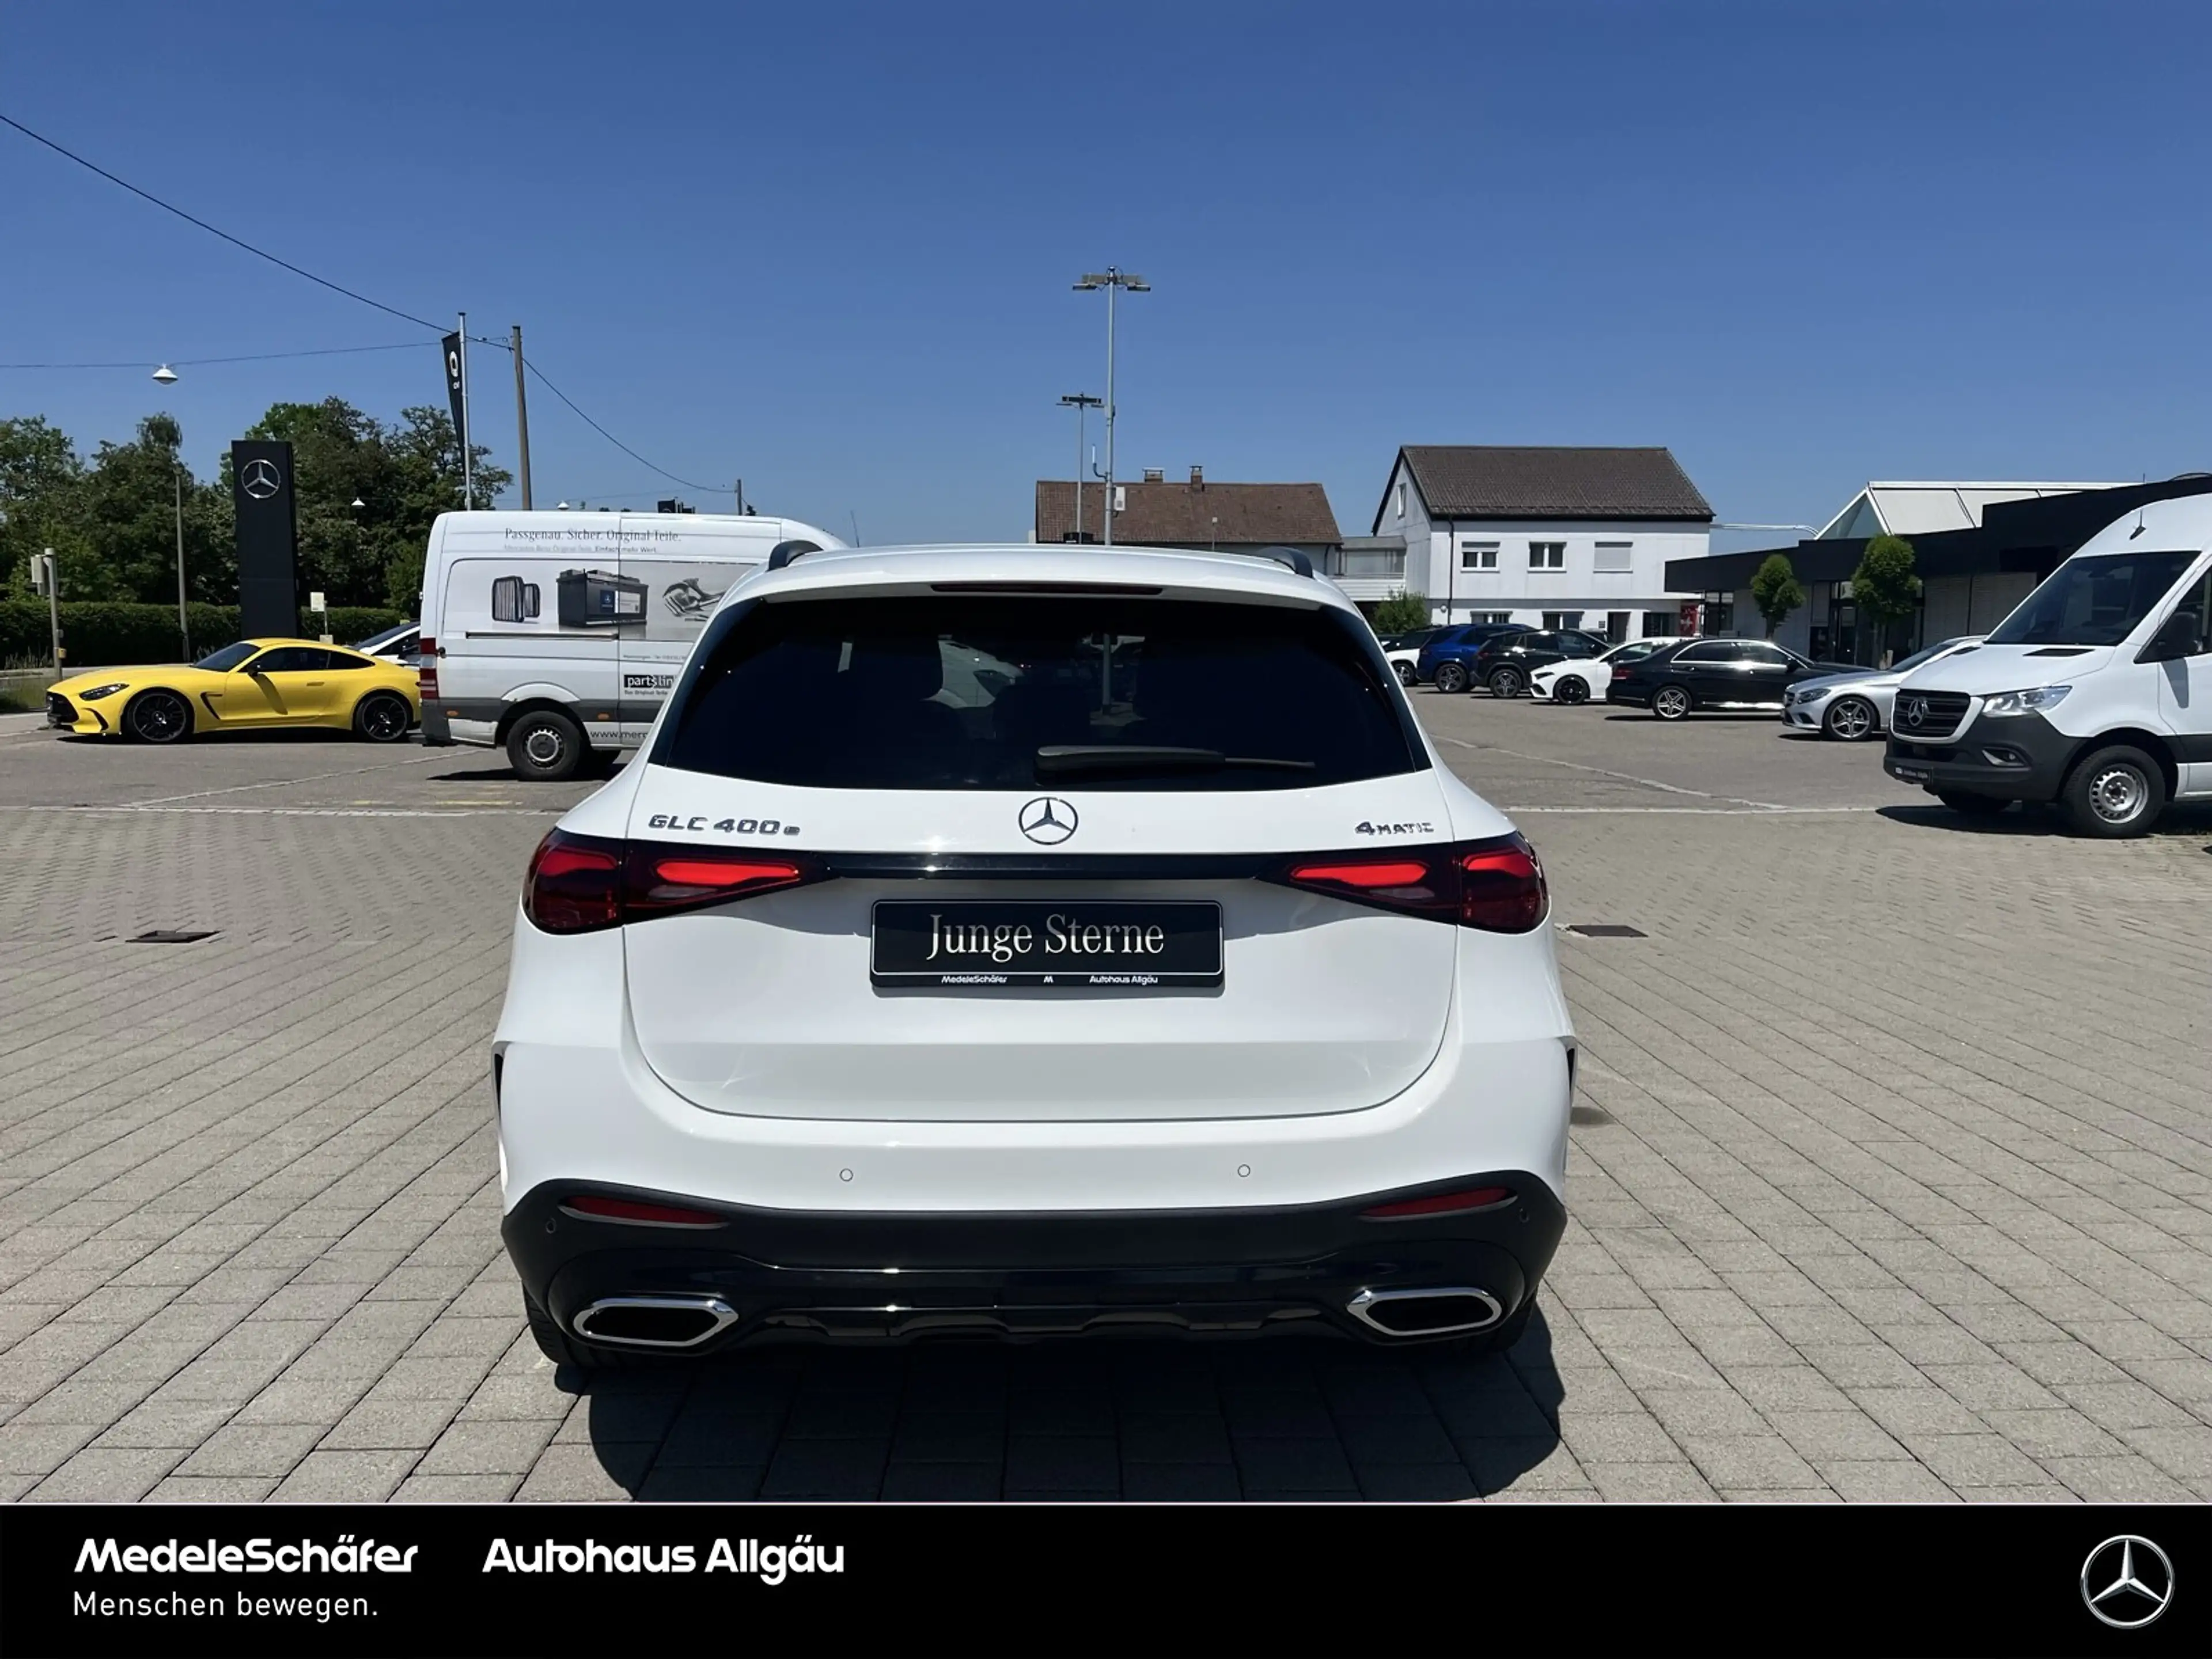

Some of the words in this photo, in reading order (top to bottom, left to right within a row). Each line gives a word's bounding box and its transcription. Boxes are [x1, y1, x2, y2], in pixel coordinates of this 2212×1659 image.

[505, 528, 563, 542] Passgenau.
[567, 528, 603, 540] Sicher.
[649, 814, 708, 831] GLC
[1355, 821, 1434, 835] 4MATIC
[926, 914, 1033, 963] Junge
[1045, 914, 1164, 954] Sterne
[941, 974, 1007, 984] MedeleSchäfer
[1089, 975, 1130, 984] Autohaus
[1131, 974, 1158, 985] Allgäu
